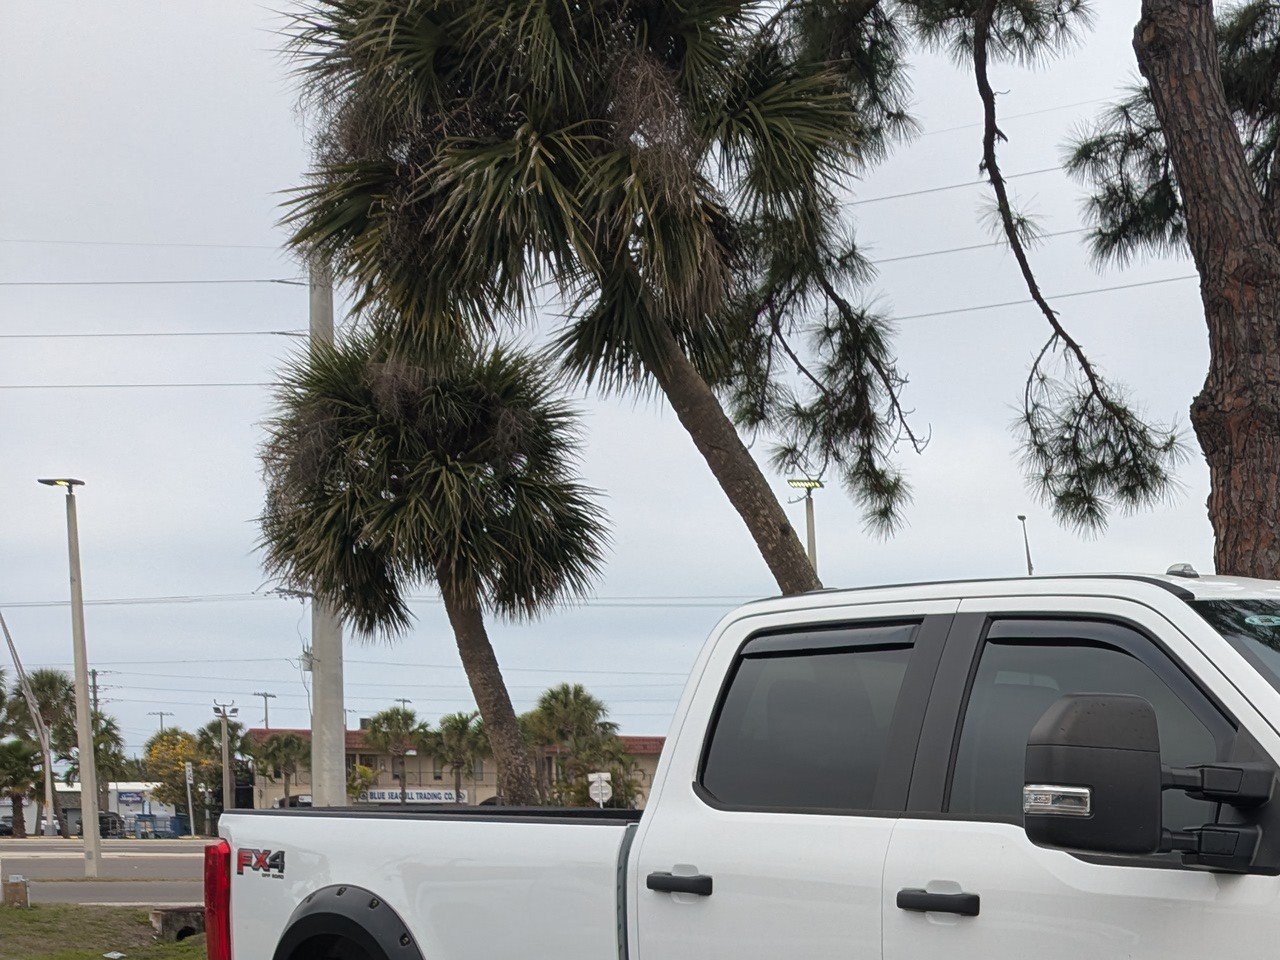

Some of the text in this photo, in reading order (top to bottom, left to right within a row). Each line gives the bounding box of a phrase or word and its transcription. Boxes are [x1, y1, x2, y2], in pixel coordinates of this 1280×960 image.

[369, 792, 385, 800] BLUE
[415, 791, 442, 800] TRADING
[236, 847, 285, 875] FX4
